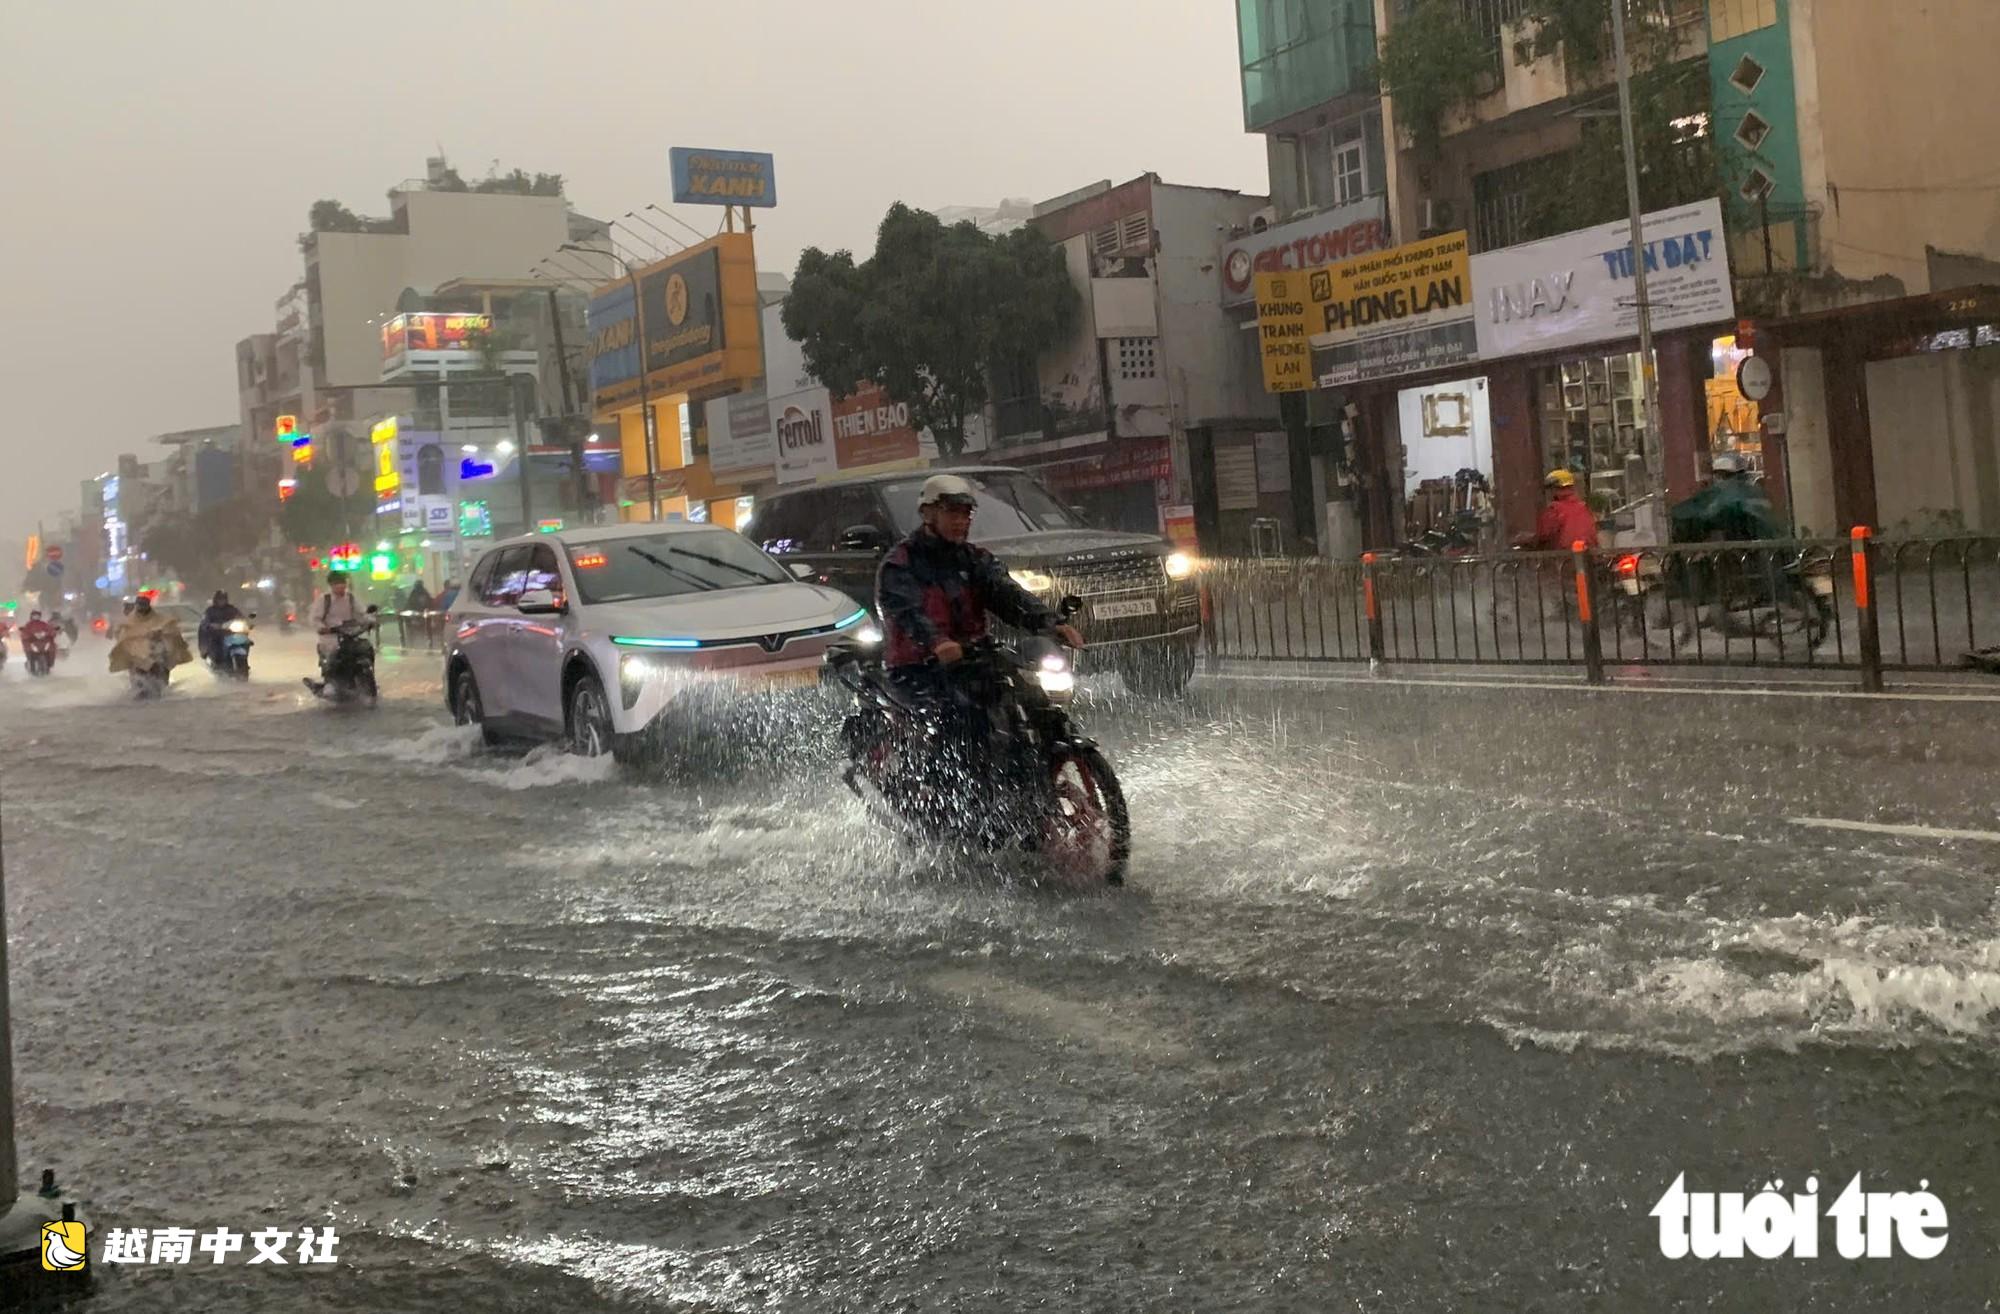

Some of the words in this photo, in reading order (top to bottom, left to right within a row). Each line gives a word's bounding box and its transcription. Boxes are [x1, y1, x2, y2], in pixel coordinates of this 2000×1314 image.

[689, 175, 766, 198] XANH
[1292, 217, 1384, 268] TOWER
[1323, 288, 1407, 332] PHONG
[1410, 275, 1463, 314] LAN
[1490, 270, 1578, 324] INAX
[1259, 302, 1304, 317] KHUNG
[1262, 323, 1304, 338] TRANH
[1265, 343, 1306, 357] PHONG
[1275, 361, 1301, 375] LAN
[776, 409, 824, 457] Ferroli
